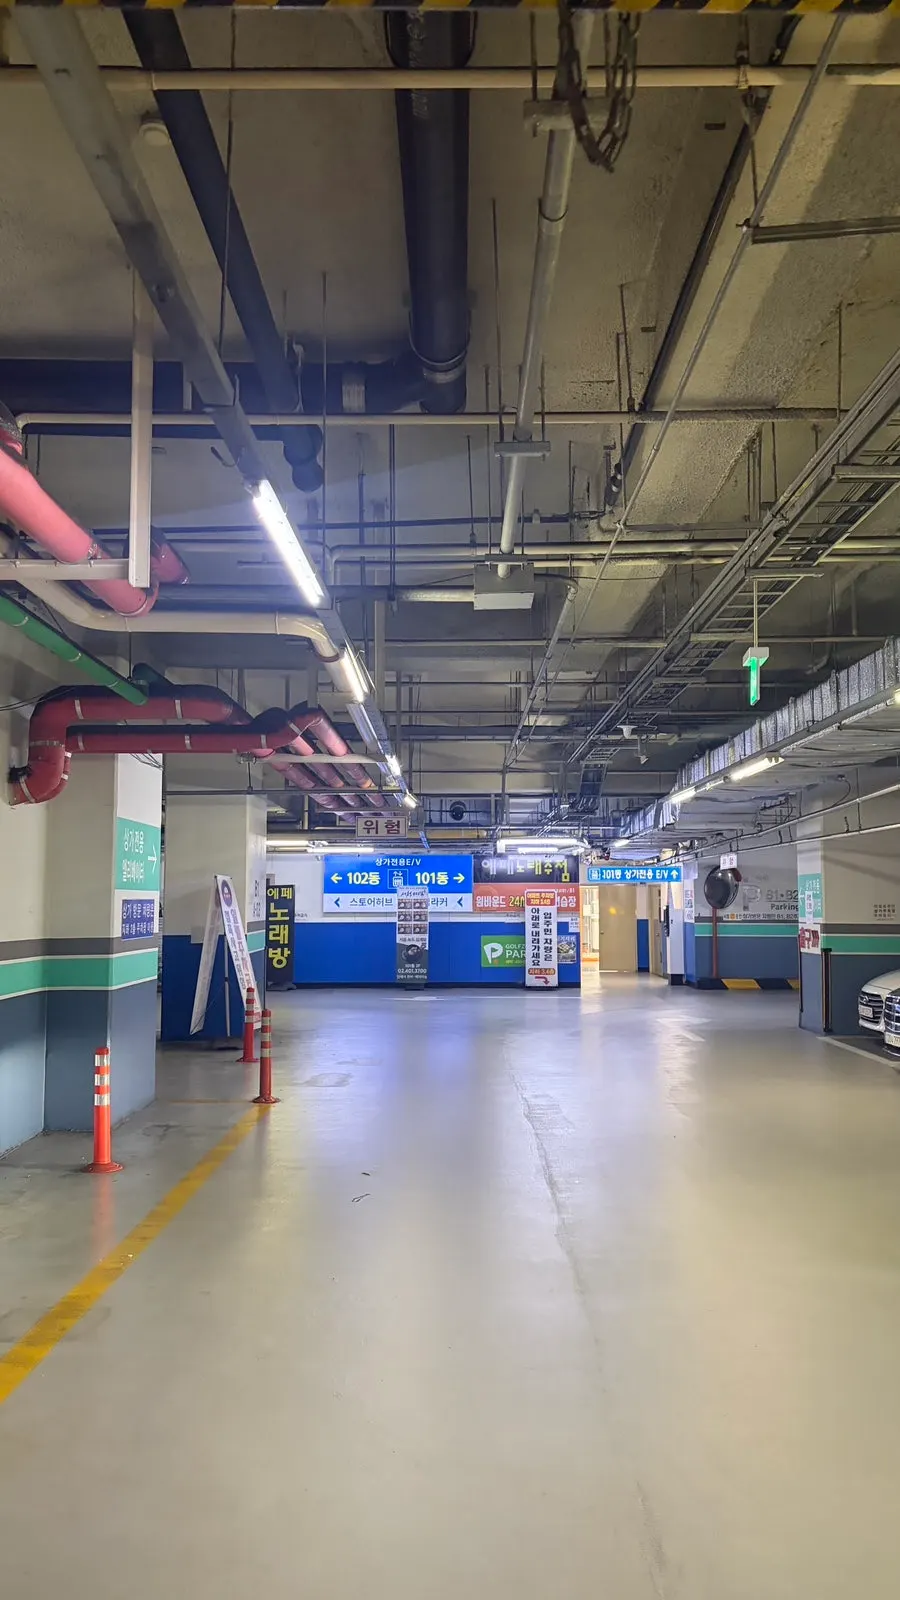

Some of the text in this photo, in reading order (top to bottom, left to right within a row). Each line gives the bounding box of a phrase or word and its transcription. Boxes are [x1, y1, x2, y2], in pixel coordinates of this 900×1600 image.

[363, 820, 401, 835] 위험
[124, 828, 145, 854] 상가전용
[122, 859, 145, 883] 엘리베이터
[347, 872, 449, 885] 102동 101동
[602, 869, 669, 880] 101동 상가전용 E/V
[267, 888, 293, 899] 에페
[350, 898, 394, 907] 스토어허브
[122, 903, 132, 919] 상가
[133, 903, 142, 919] 방문
[268, 903, 291, 969] 노래방
[531, 907, 540, 966] 아래로 내려가세요
[543, 912, 552, 962] 입주민 차량은
